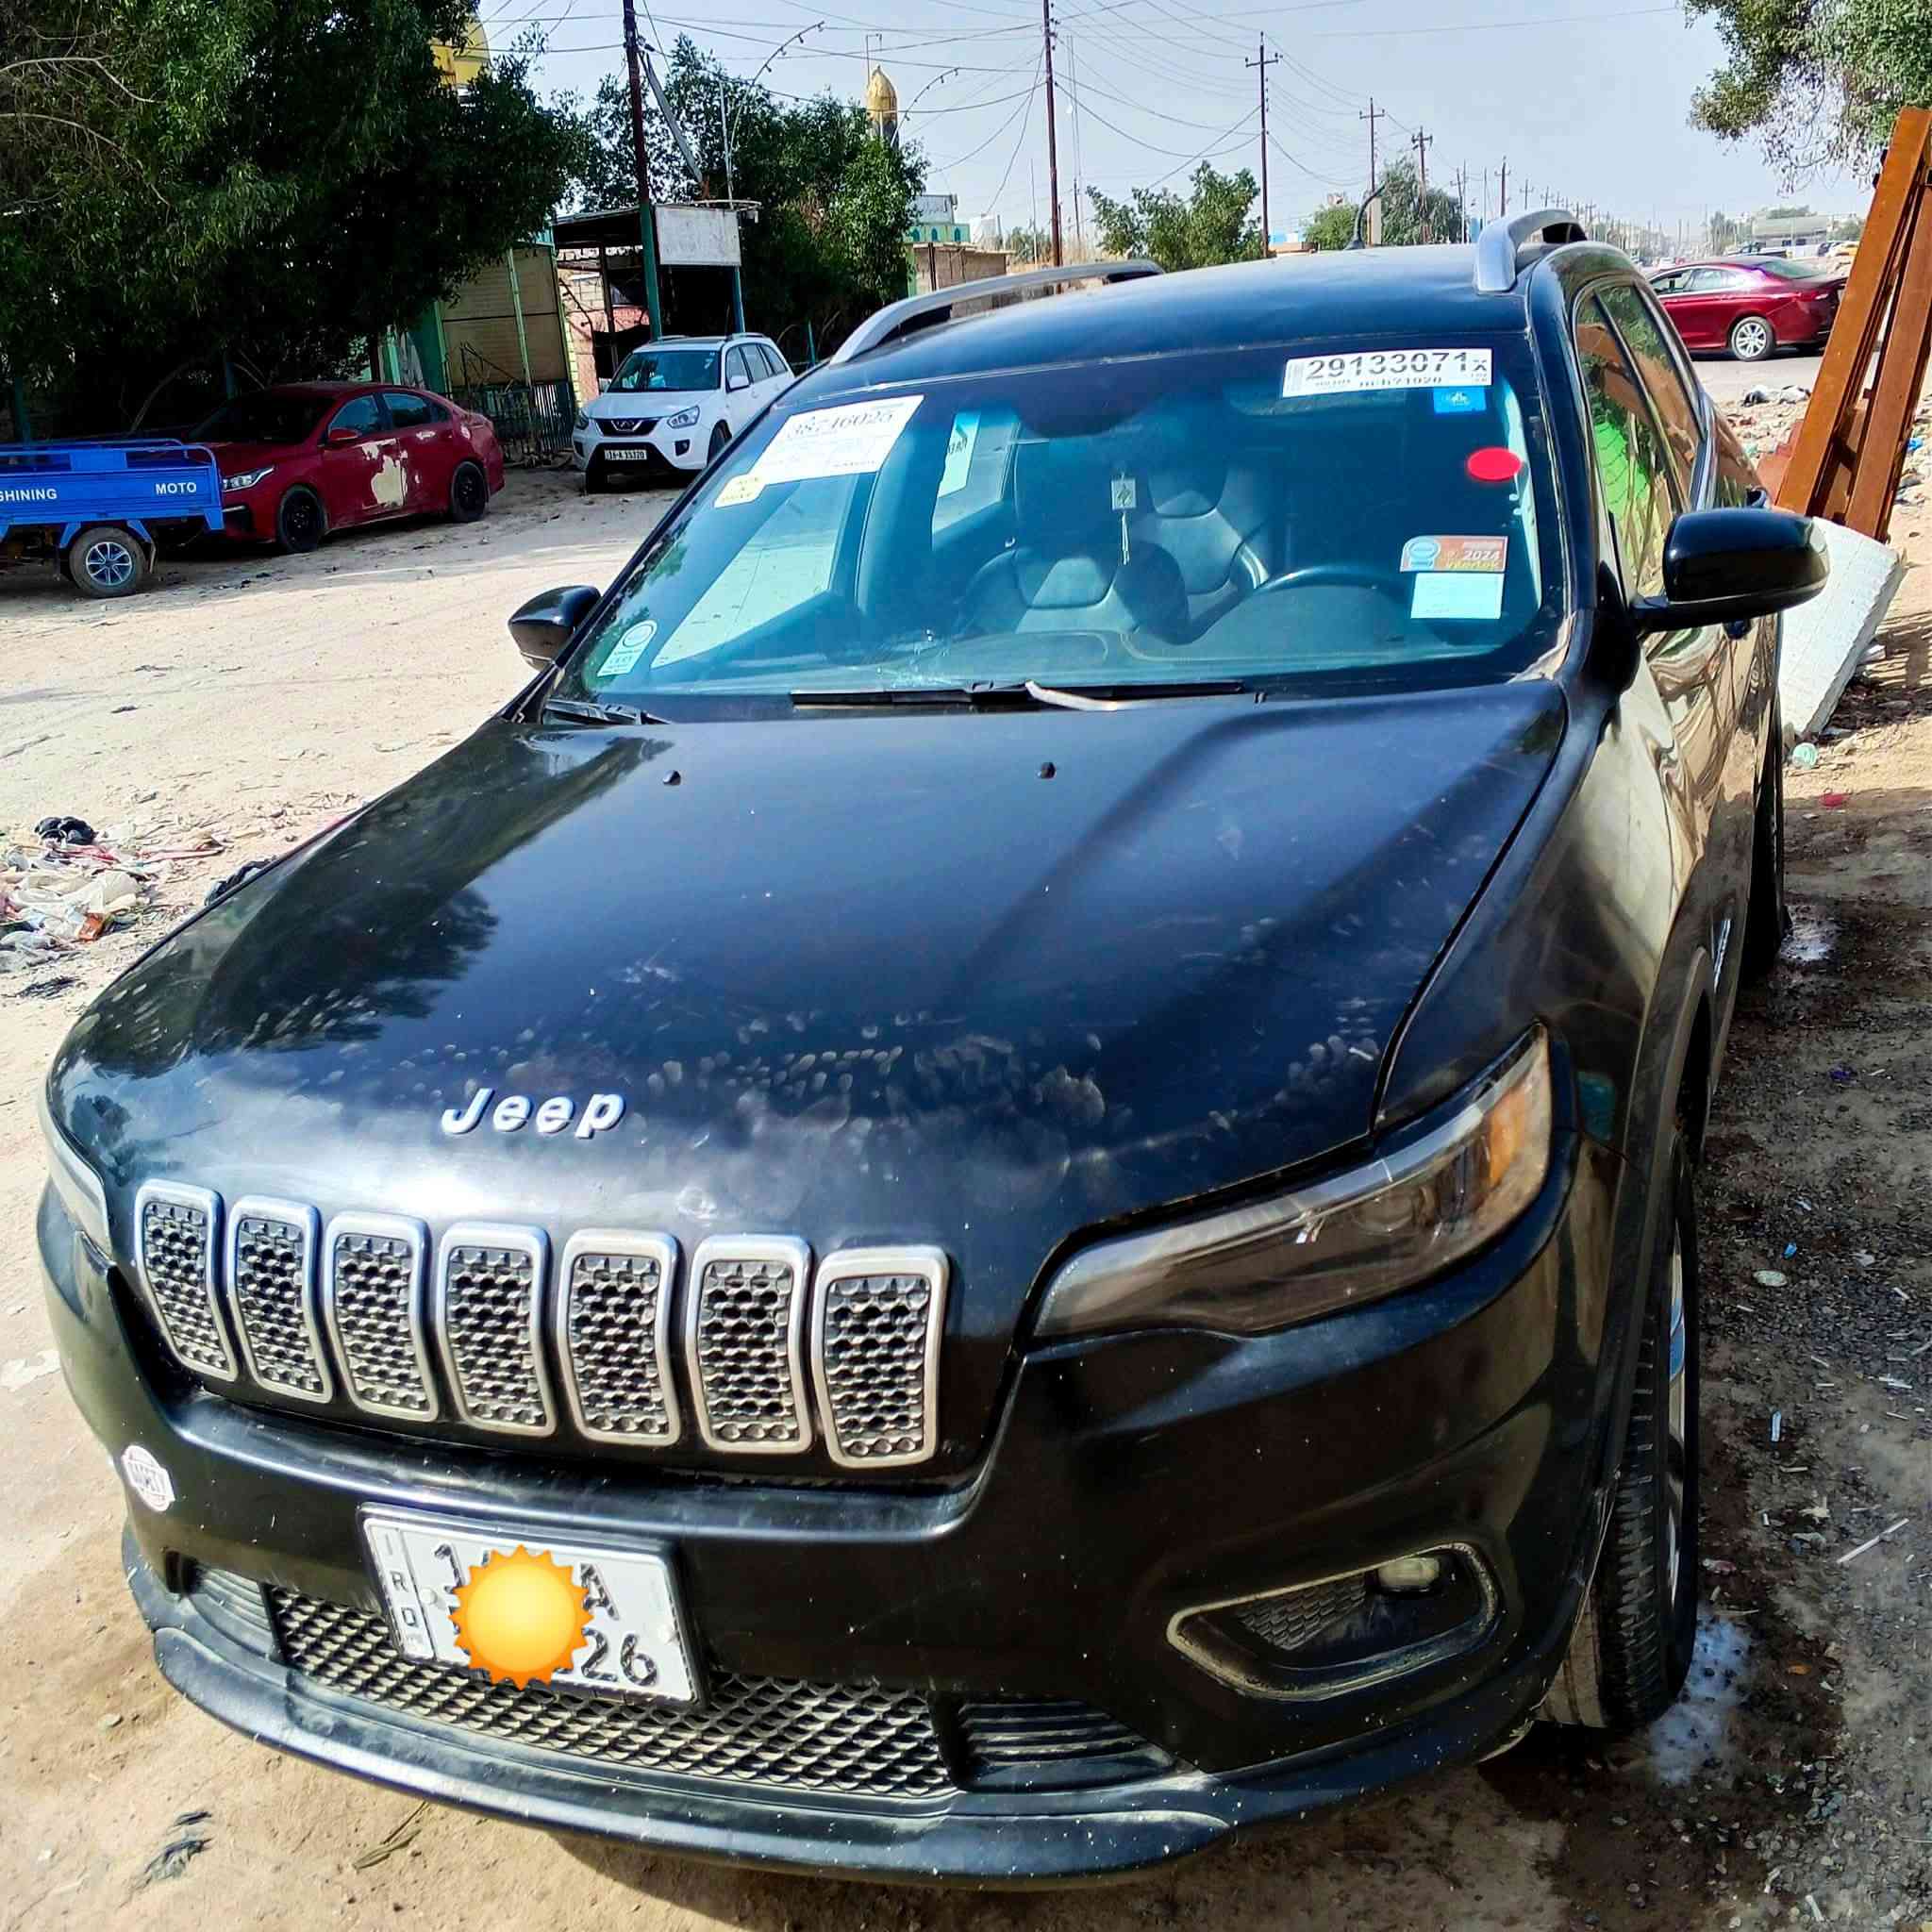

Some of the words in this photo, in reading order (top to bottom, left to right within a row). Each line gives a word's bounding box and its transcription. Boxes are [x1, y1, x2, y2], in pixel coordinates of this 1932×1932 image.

[1307, 352, 1468, 379] 29133071
[156, 482, 197, 494] MOTO
[441, 1088, 625, 1140] Jeep
